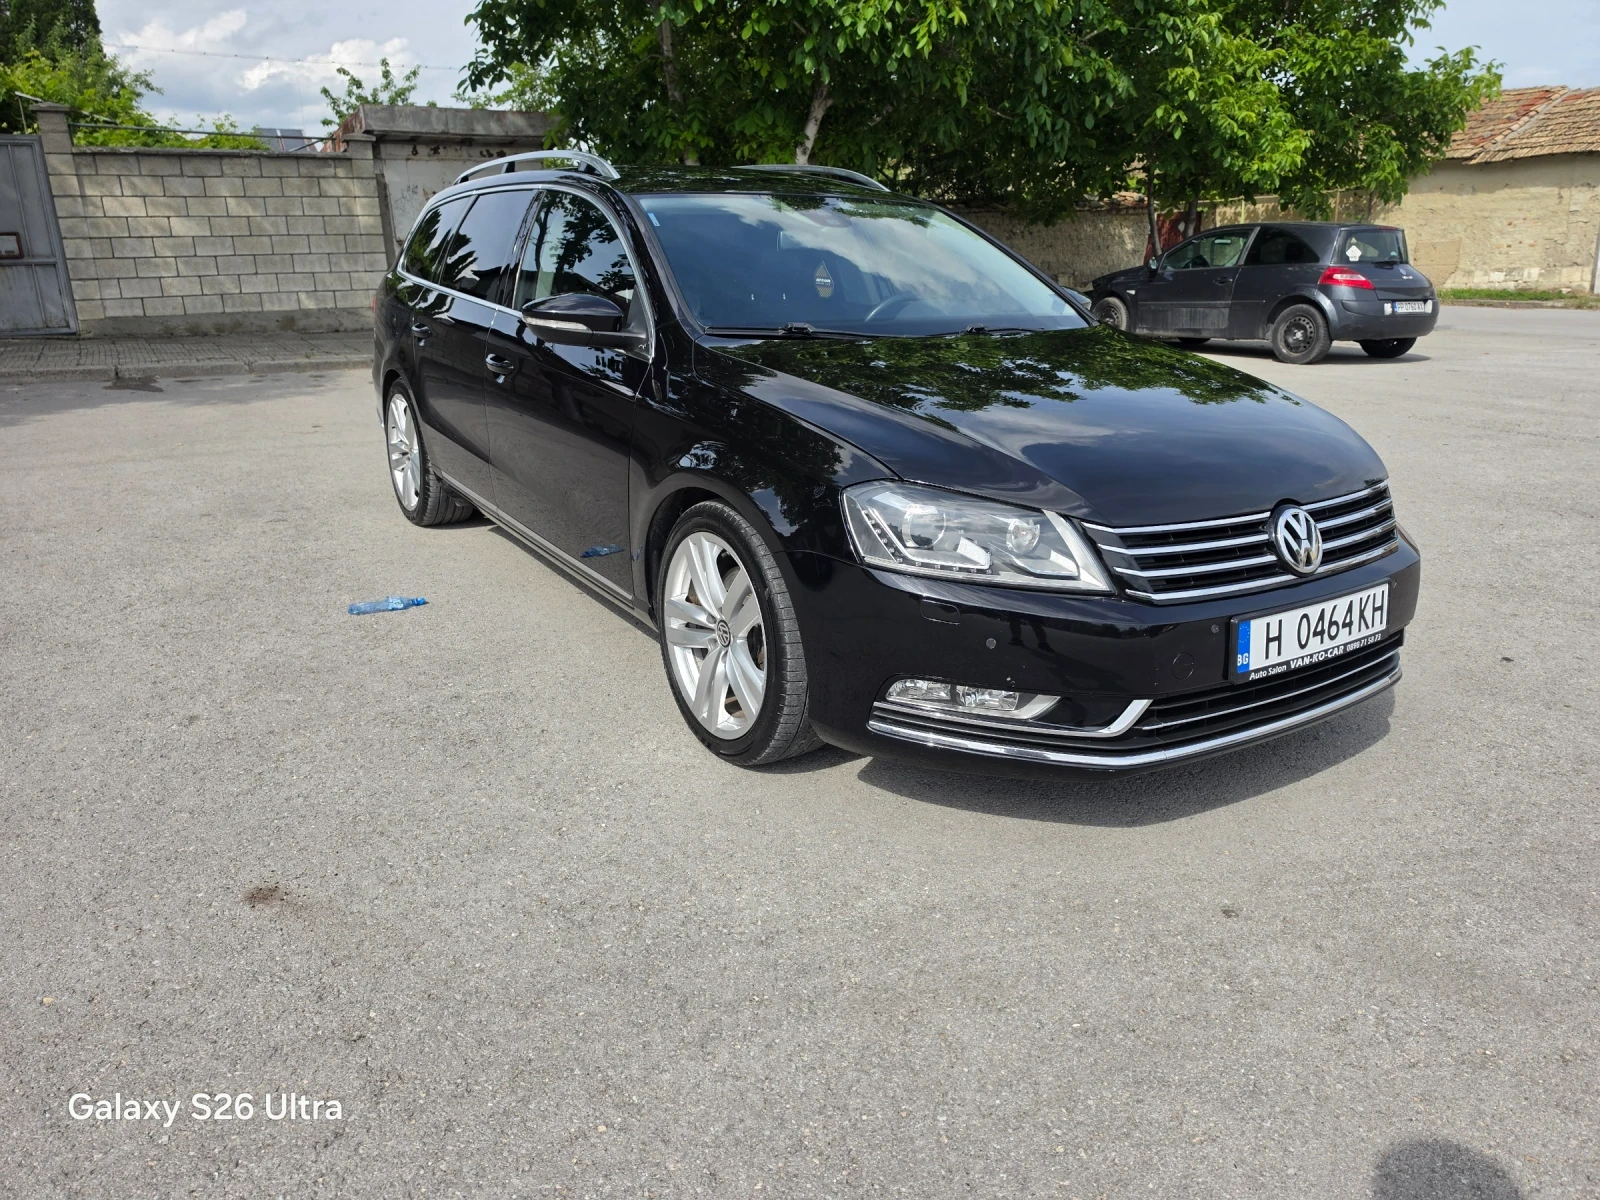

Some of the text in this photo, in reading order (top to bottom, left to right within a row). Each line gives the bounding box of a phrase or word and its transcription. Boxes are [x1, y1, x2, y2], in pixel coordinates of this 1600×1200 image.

[1264, 618, 1283, 660] H
[1237, 654, 1249, 666] BG
[1249, 667, 1267, 680] Auto
[1268, 665, 1287, 676] Salon
[1290, 645, 1345, 669] VAN-KO-CAR
